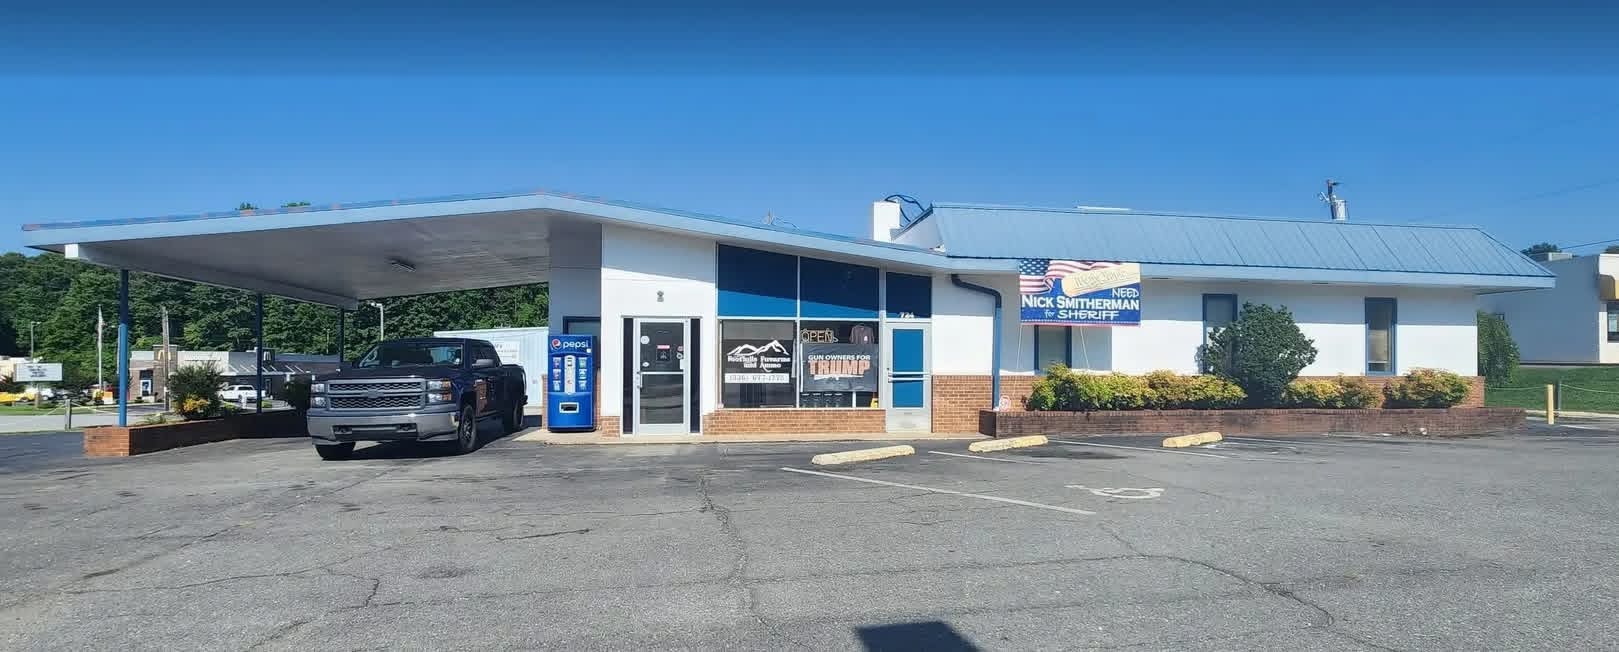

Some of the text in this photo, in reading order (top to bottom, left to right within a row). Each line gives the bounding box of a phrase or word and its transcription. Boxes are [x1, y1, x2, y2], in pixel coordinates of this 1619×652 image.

[1112, 288, 1139, 298] NEED
[1022, 295, 1139, 311] NICK SMITHERMAN
[1044, 309, 1119, 320] for SHERIFF
[801, 329, 832, 343] OPEN
[563, 339, 589, 350] pepsi
[808, 360, 870, 375] TRUMP
